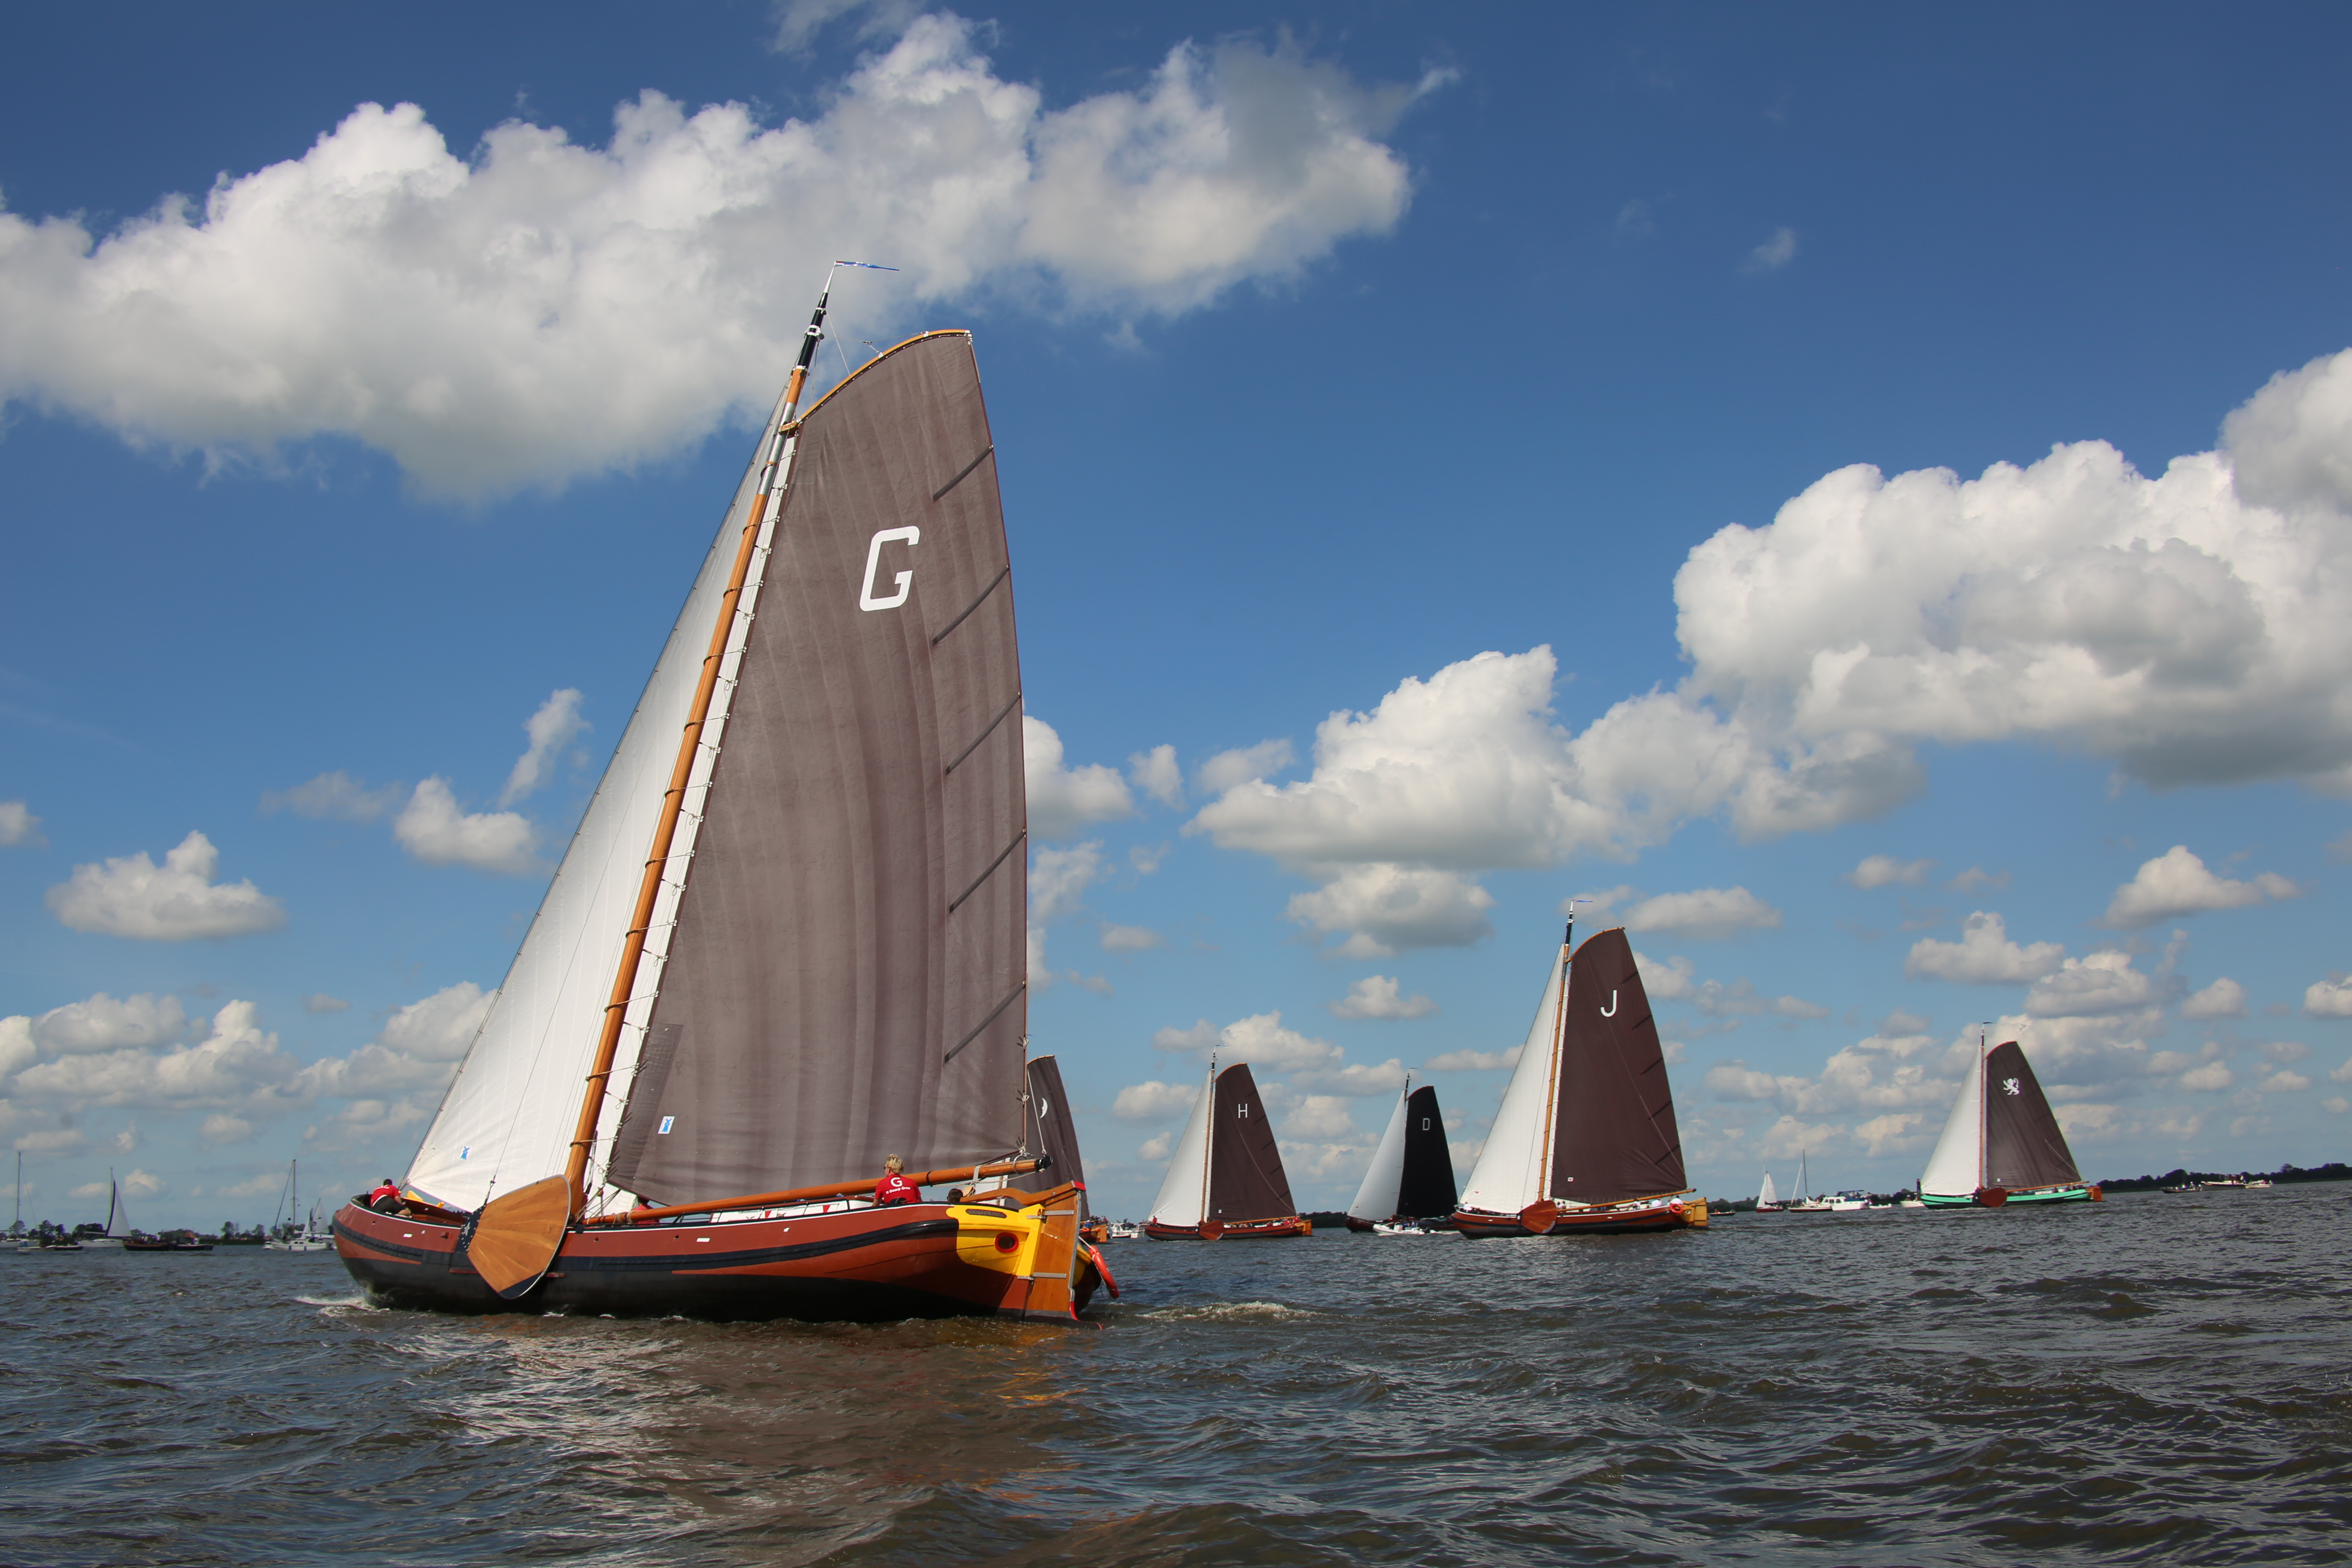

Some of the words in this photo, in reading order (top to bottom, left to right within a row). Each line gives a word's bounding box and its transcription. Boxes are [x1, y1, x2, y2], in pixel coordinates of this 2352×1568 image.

[860, 526, 920, 612] G
[1600, 989, 1617, 1017] J
[1238, 1103, 1248, 1118] H
[1423, 1118, 1430, 1131] D
[890, 1177, 903, 1187] G
